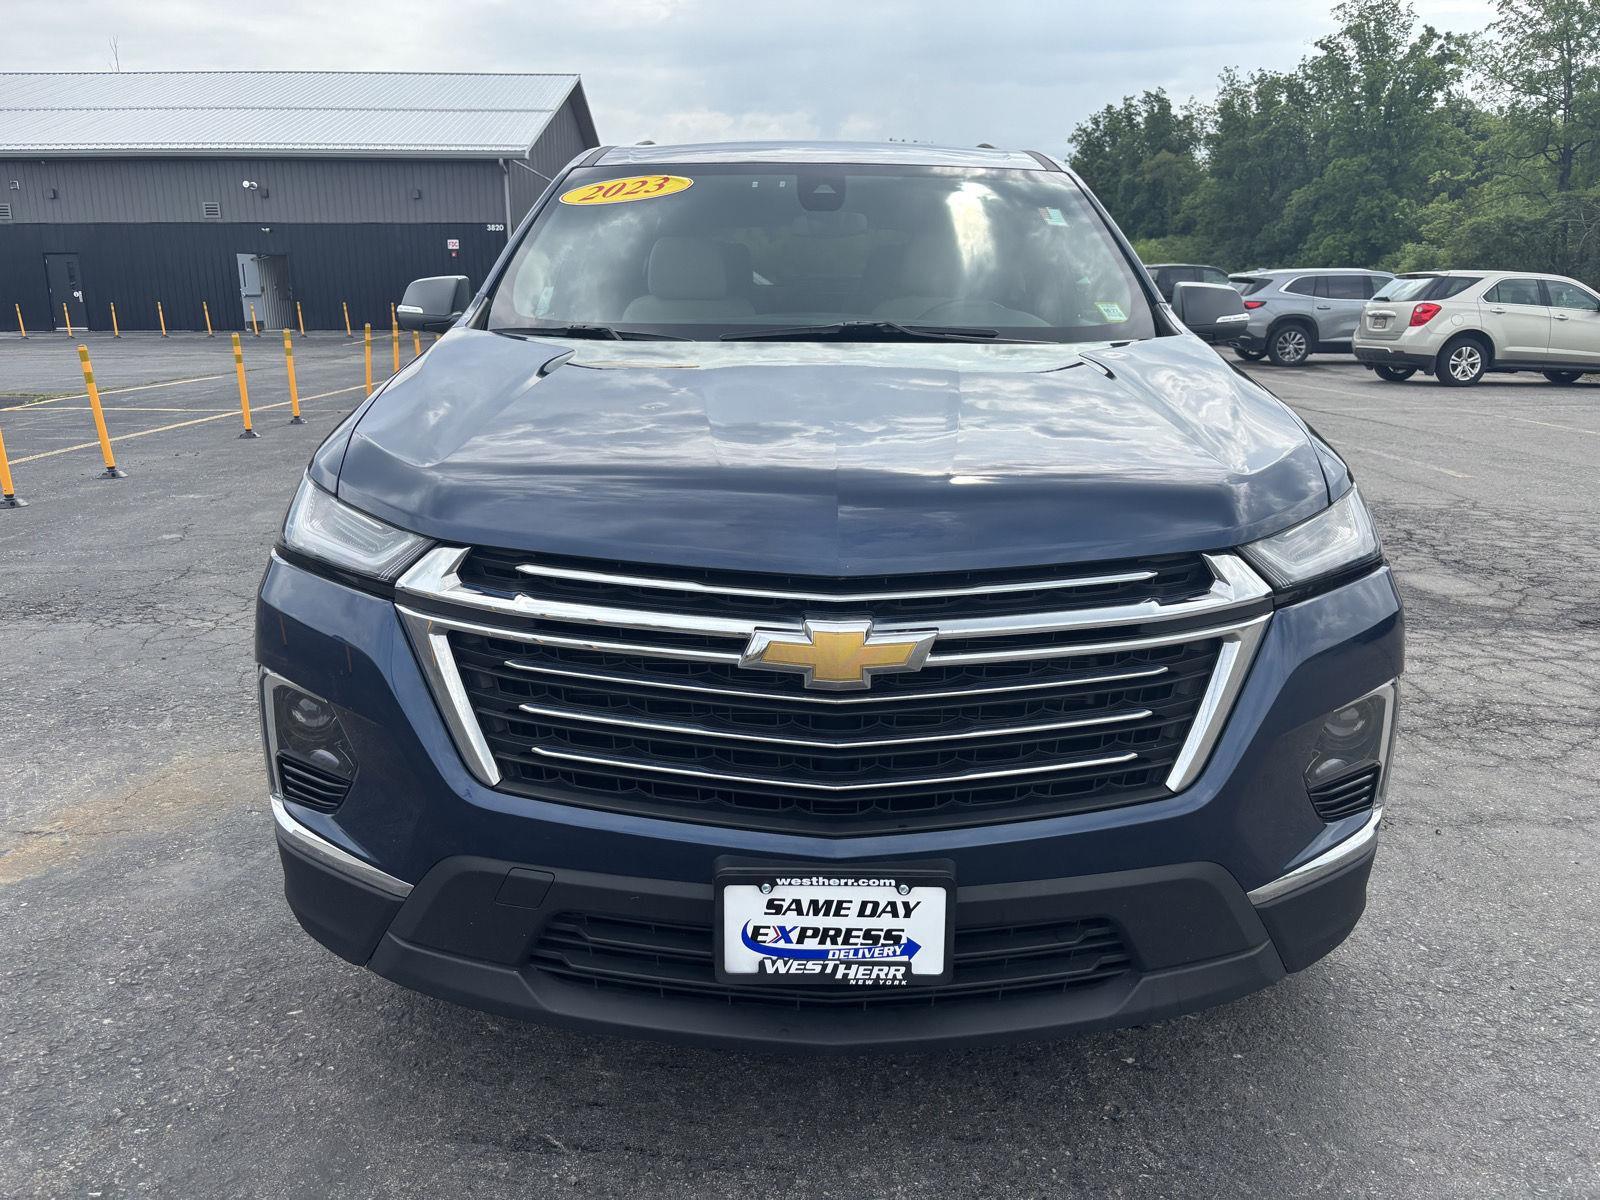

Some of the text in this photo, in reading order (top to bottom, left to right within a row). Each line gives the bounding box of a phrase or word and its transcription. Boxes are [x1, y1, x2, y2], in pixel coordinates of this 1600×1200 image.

[577, 176, 670, 201] 2023
[776, 876, 896, 887] westherr.com
[764, 898, 922, 918] SAME DAY
[750, 925, 905, 946] EXPRESS
[828, 944, 905, 960] DELIVERY
